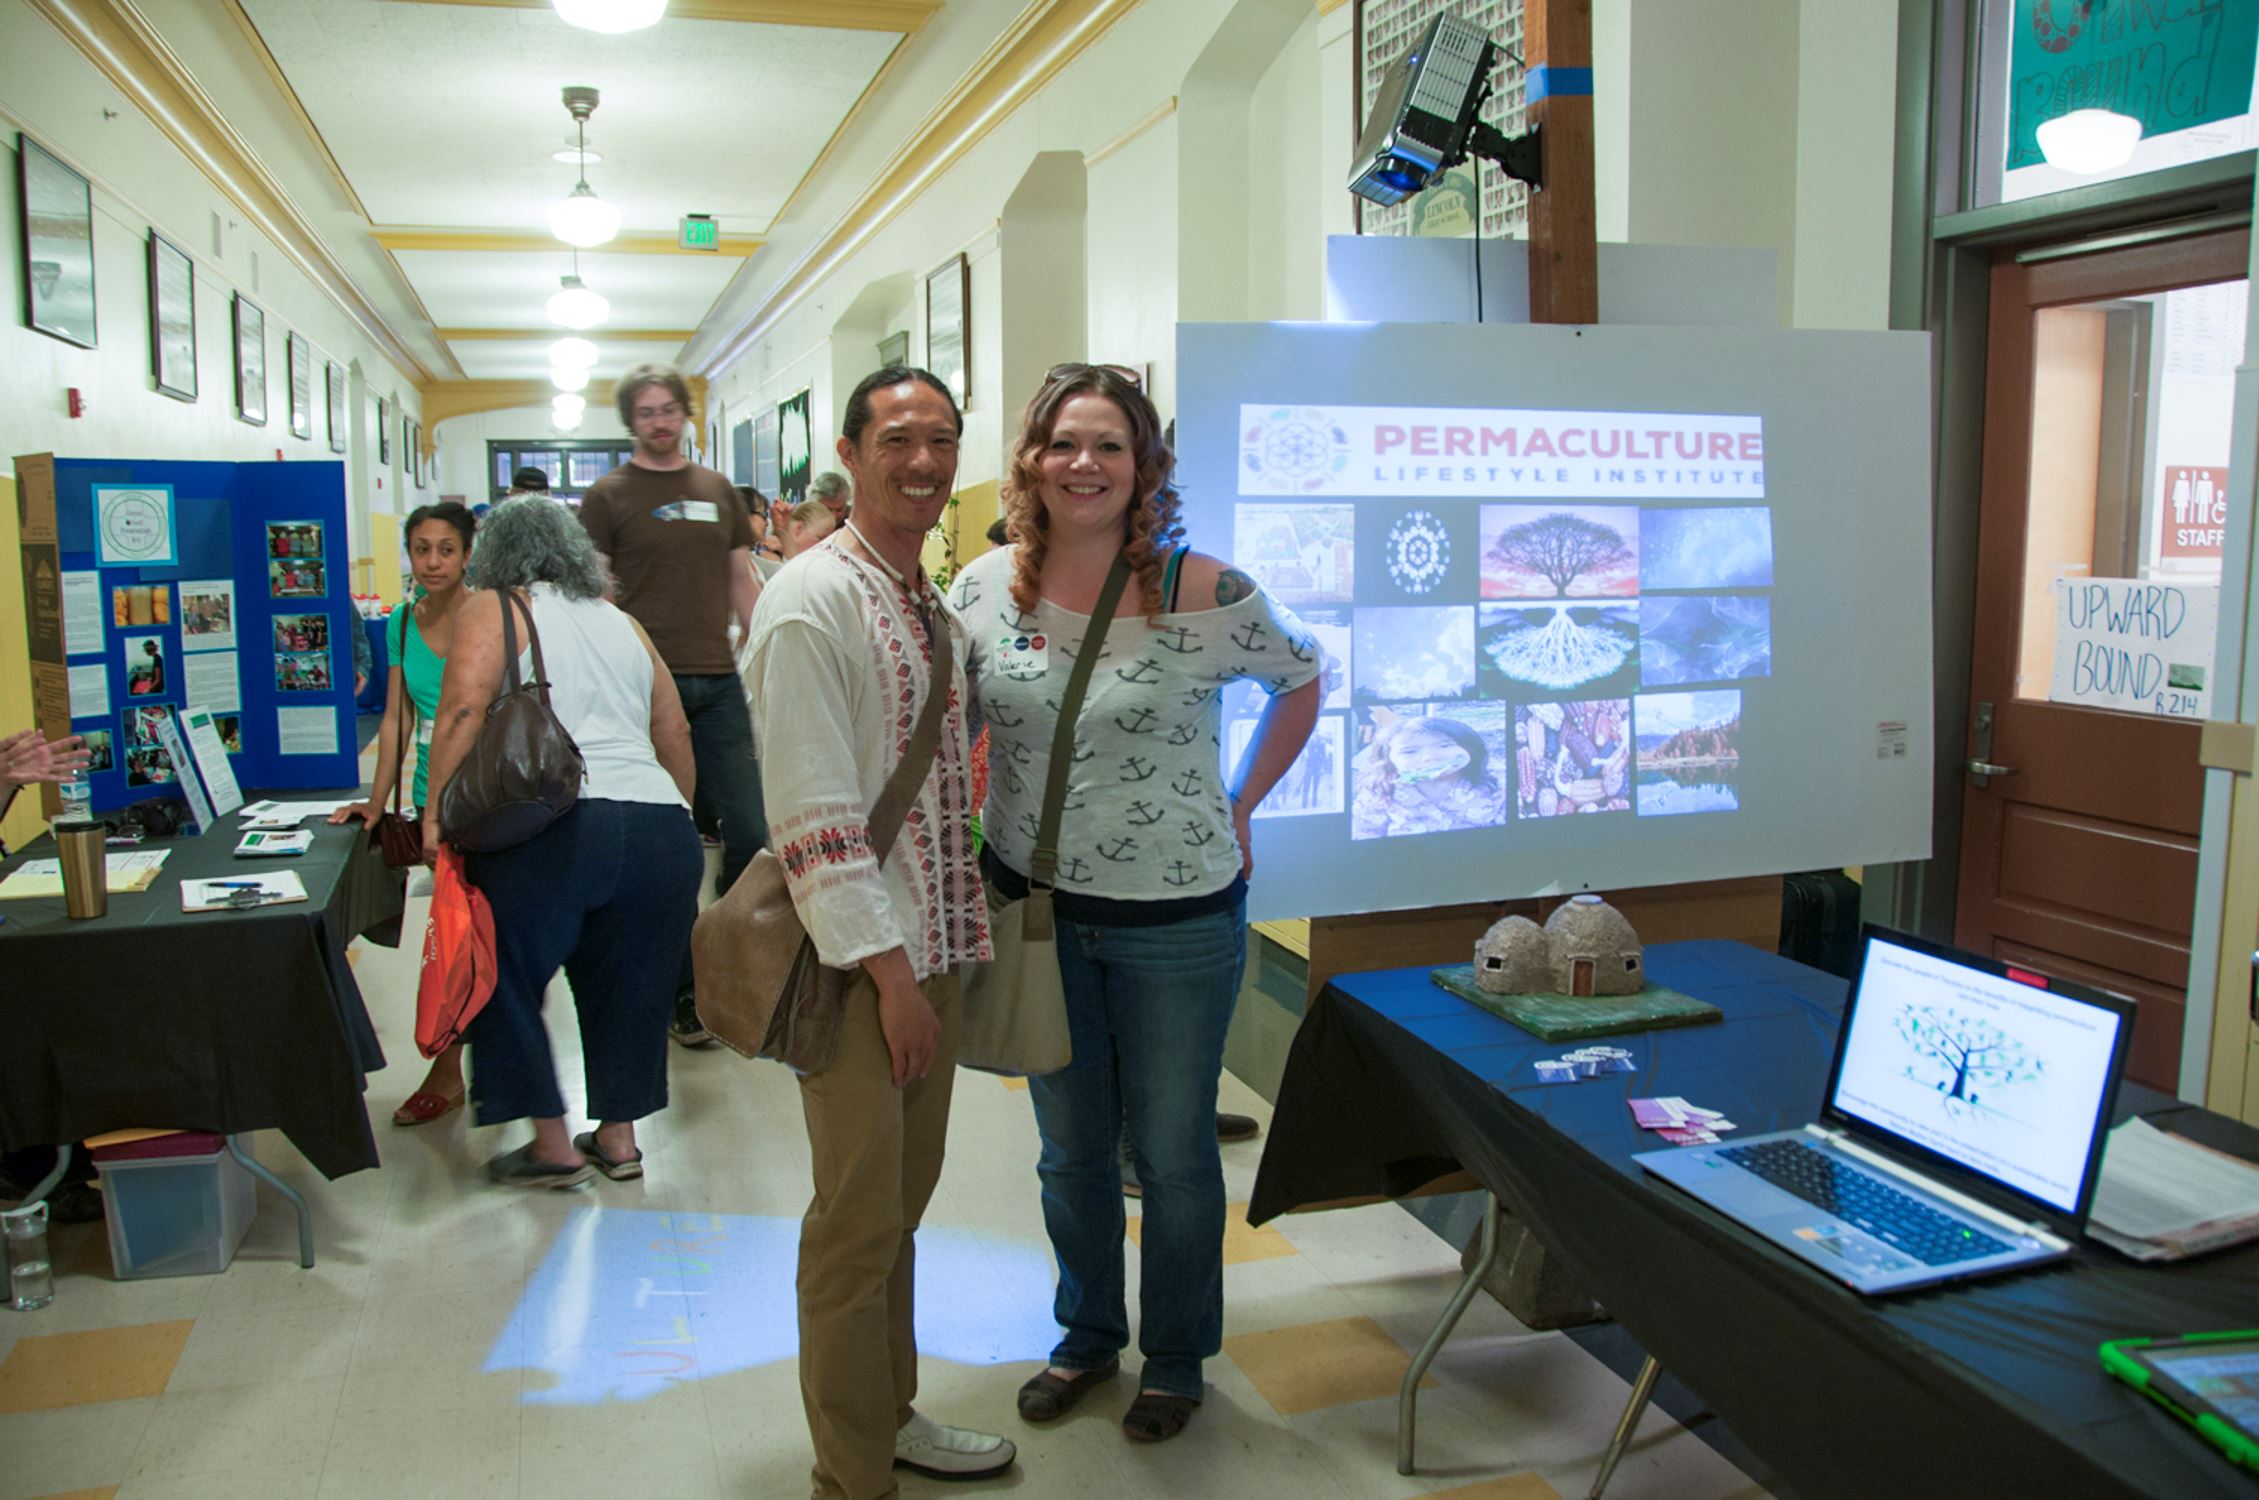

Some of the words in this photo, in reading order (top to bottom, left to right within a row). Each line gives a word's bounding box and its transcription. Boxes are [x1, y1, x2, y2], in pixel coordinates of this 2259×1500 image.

[1374, 425, 1763, 461] PERMACULTURE
[1374, 466, 1568, 483] LIFESTYLE
[1594, 468, 1765, 485] INSTITUTE
[2177, 529, 2225, 547] STAFF
[2068, 585, 2186, 640] UPWARD
[2073, 640, 2162, 700] BOUND
[2168, 694, 2198, 715] 214
